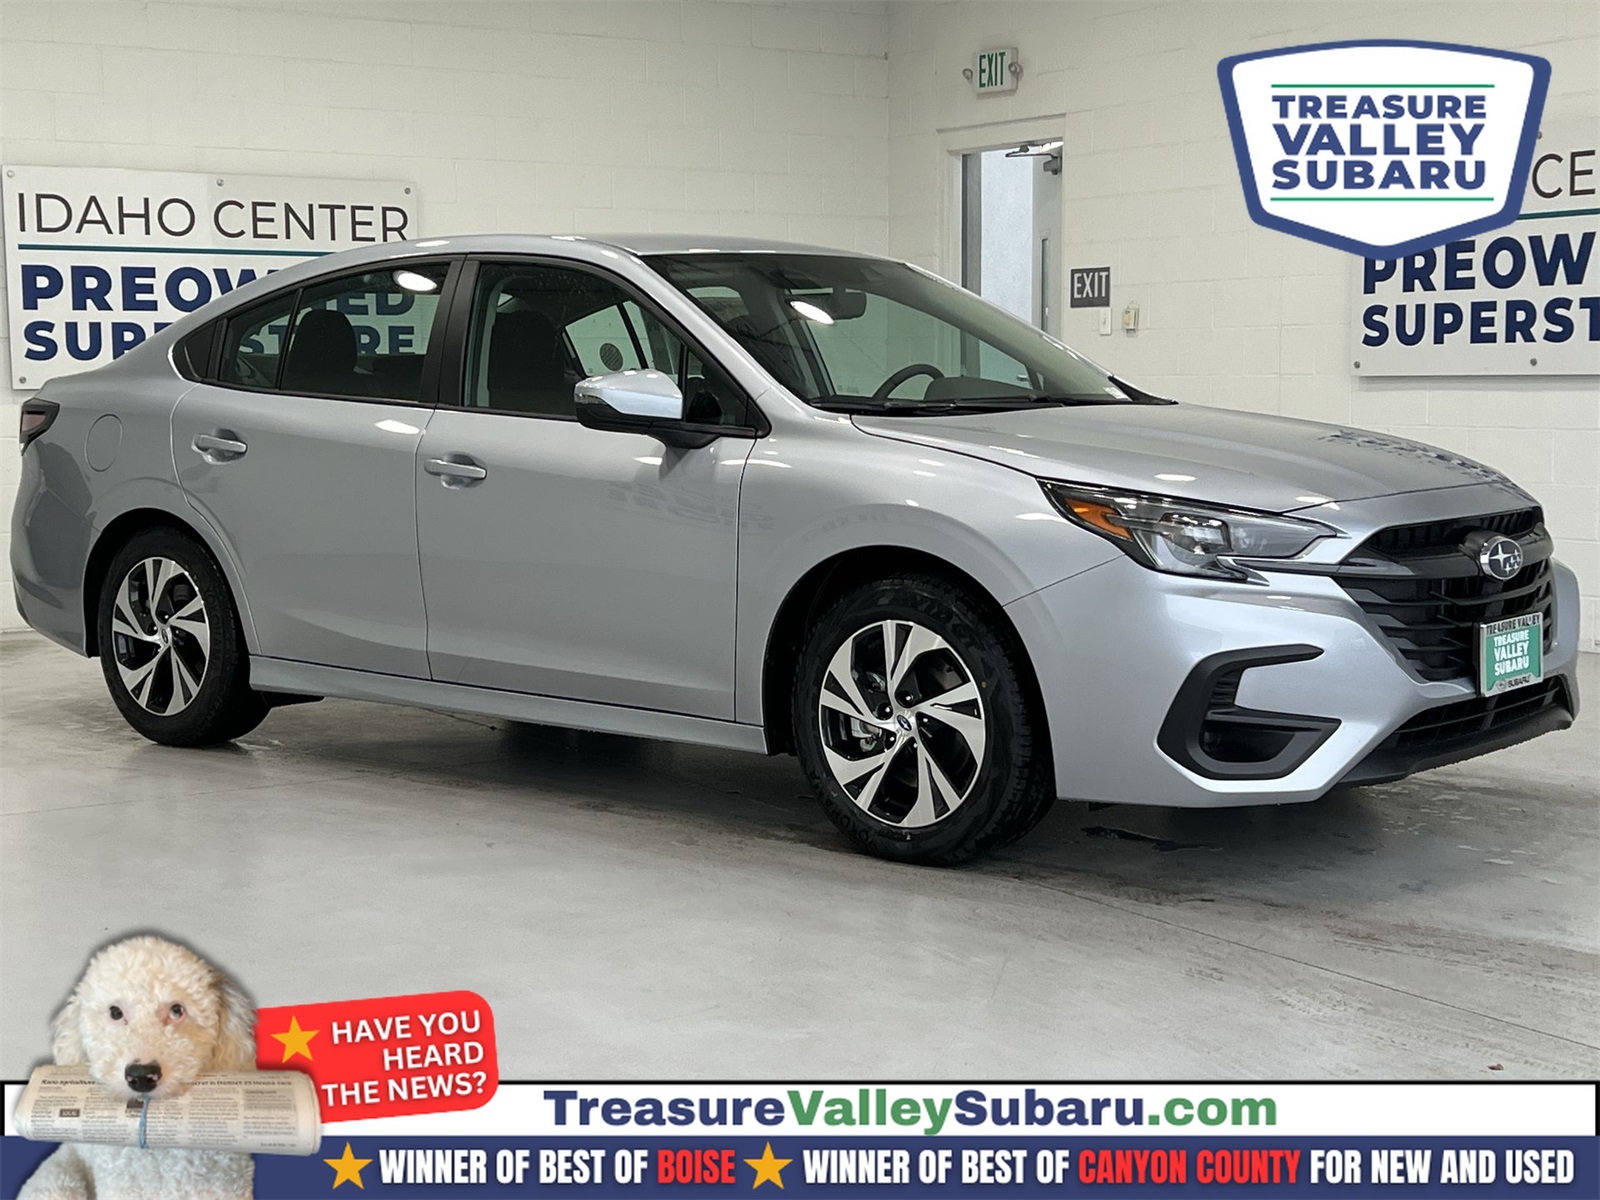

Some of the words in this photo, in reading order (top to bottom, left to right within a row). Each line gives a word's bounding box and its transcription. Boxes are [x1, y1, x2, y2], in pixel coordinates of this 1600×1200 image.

[979, 51, 1006, 88] EXIT
[1532, 150, 1596, 199] CE
[18, 192, 196, 237] IDAHO
[213, 199, 409, 243] CENTER
[1362, 231, 1597, 295] PREOW
[1073, 271, 1109, 300] EXIT
[1494, 630, 1529, 647] TREASURE
[1494, 641, 1529, 662] VALLEY
[1494, 655, 1530, 676] SUBARU
